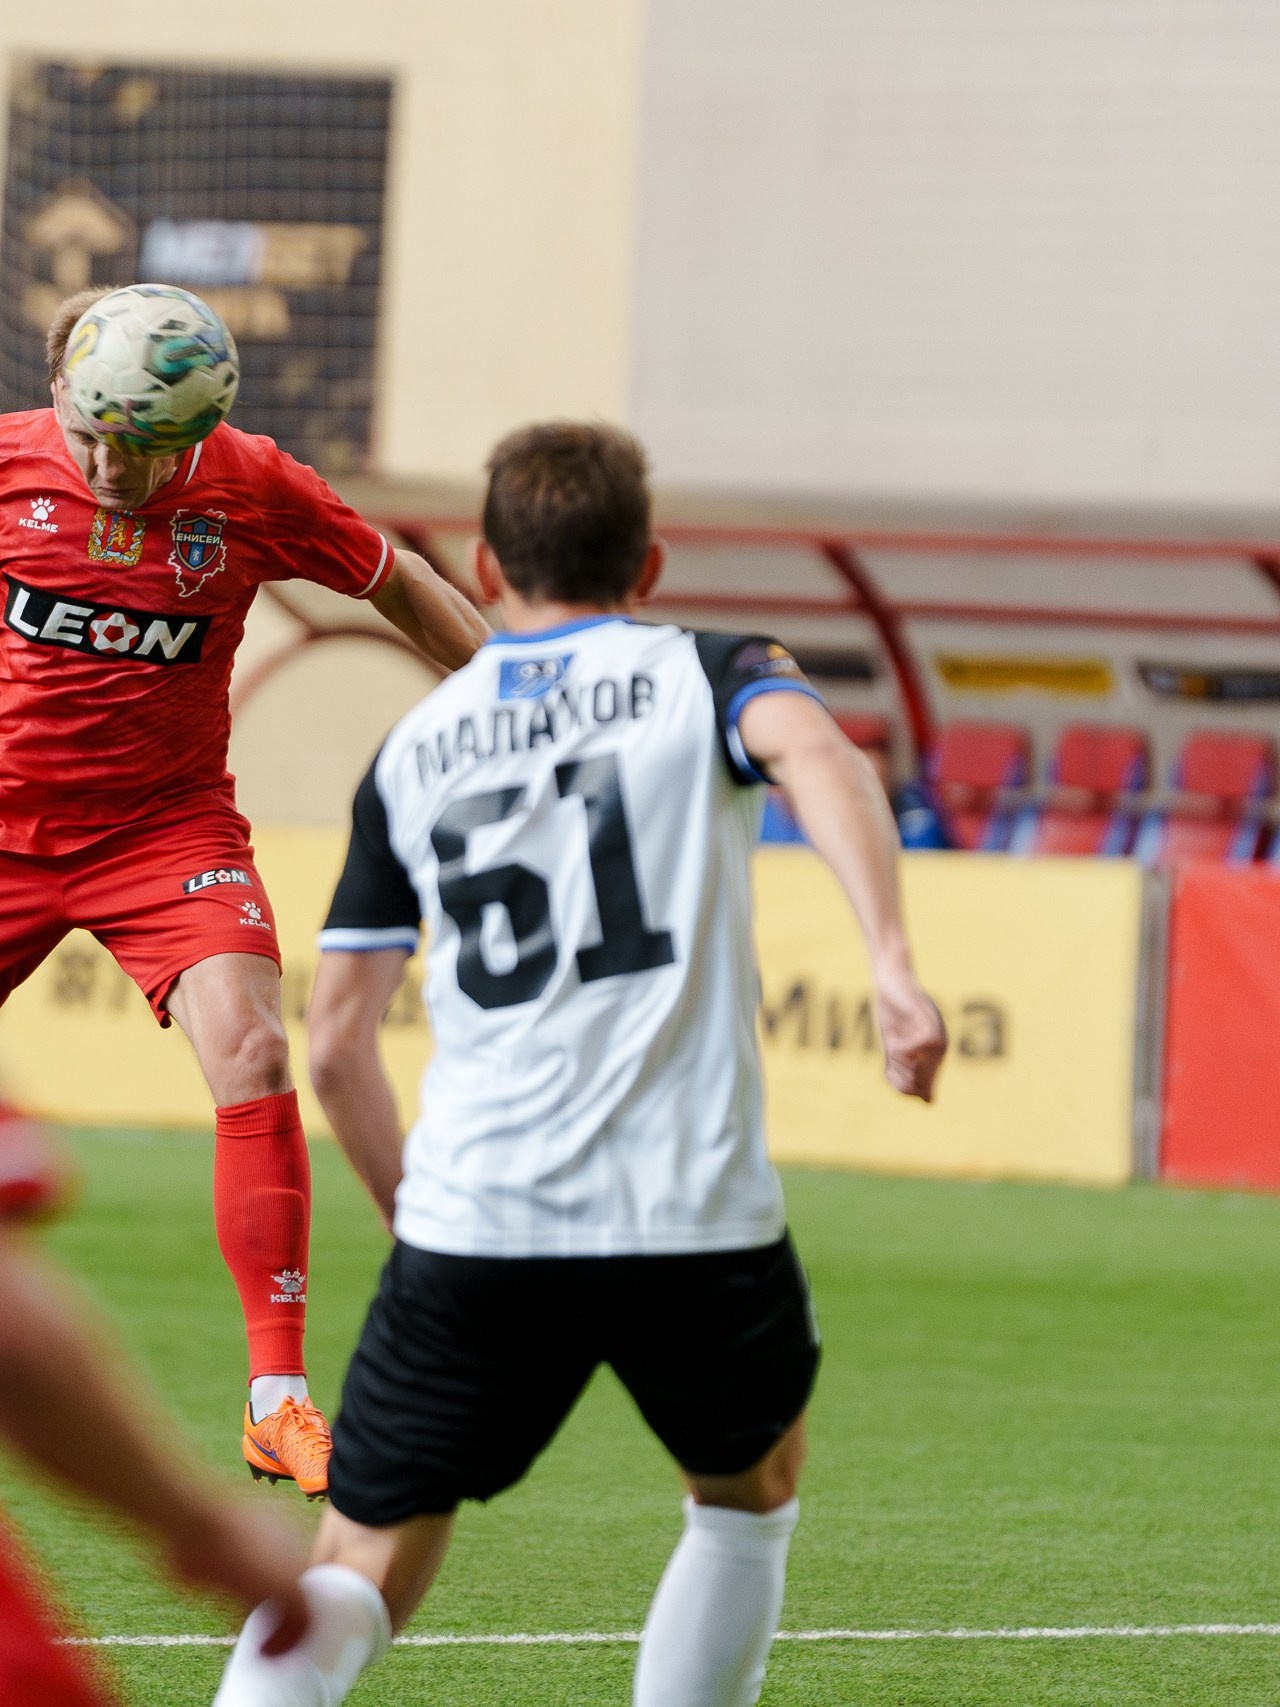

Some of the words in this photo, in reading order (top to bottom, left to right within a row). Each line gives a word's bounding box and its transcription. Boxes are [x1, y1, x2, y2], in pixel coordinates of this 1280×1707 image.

[18, 517, 58, 533] KELME
[8, 587, 197, 659] LEON
[188, 869, 246, 893] LEON
[430, 752, 676, 1010] 61
[271, 1294, 306, 1303] KELME
